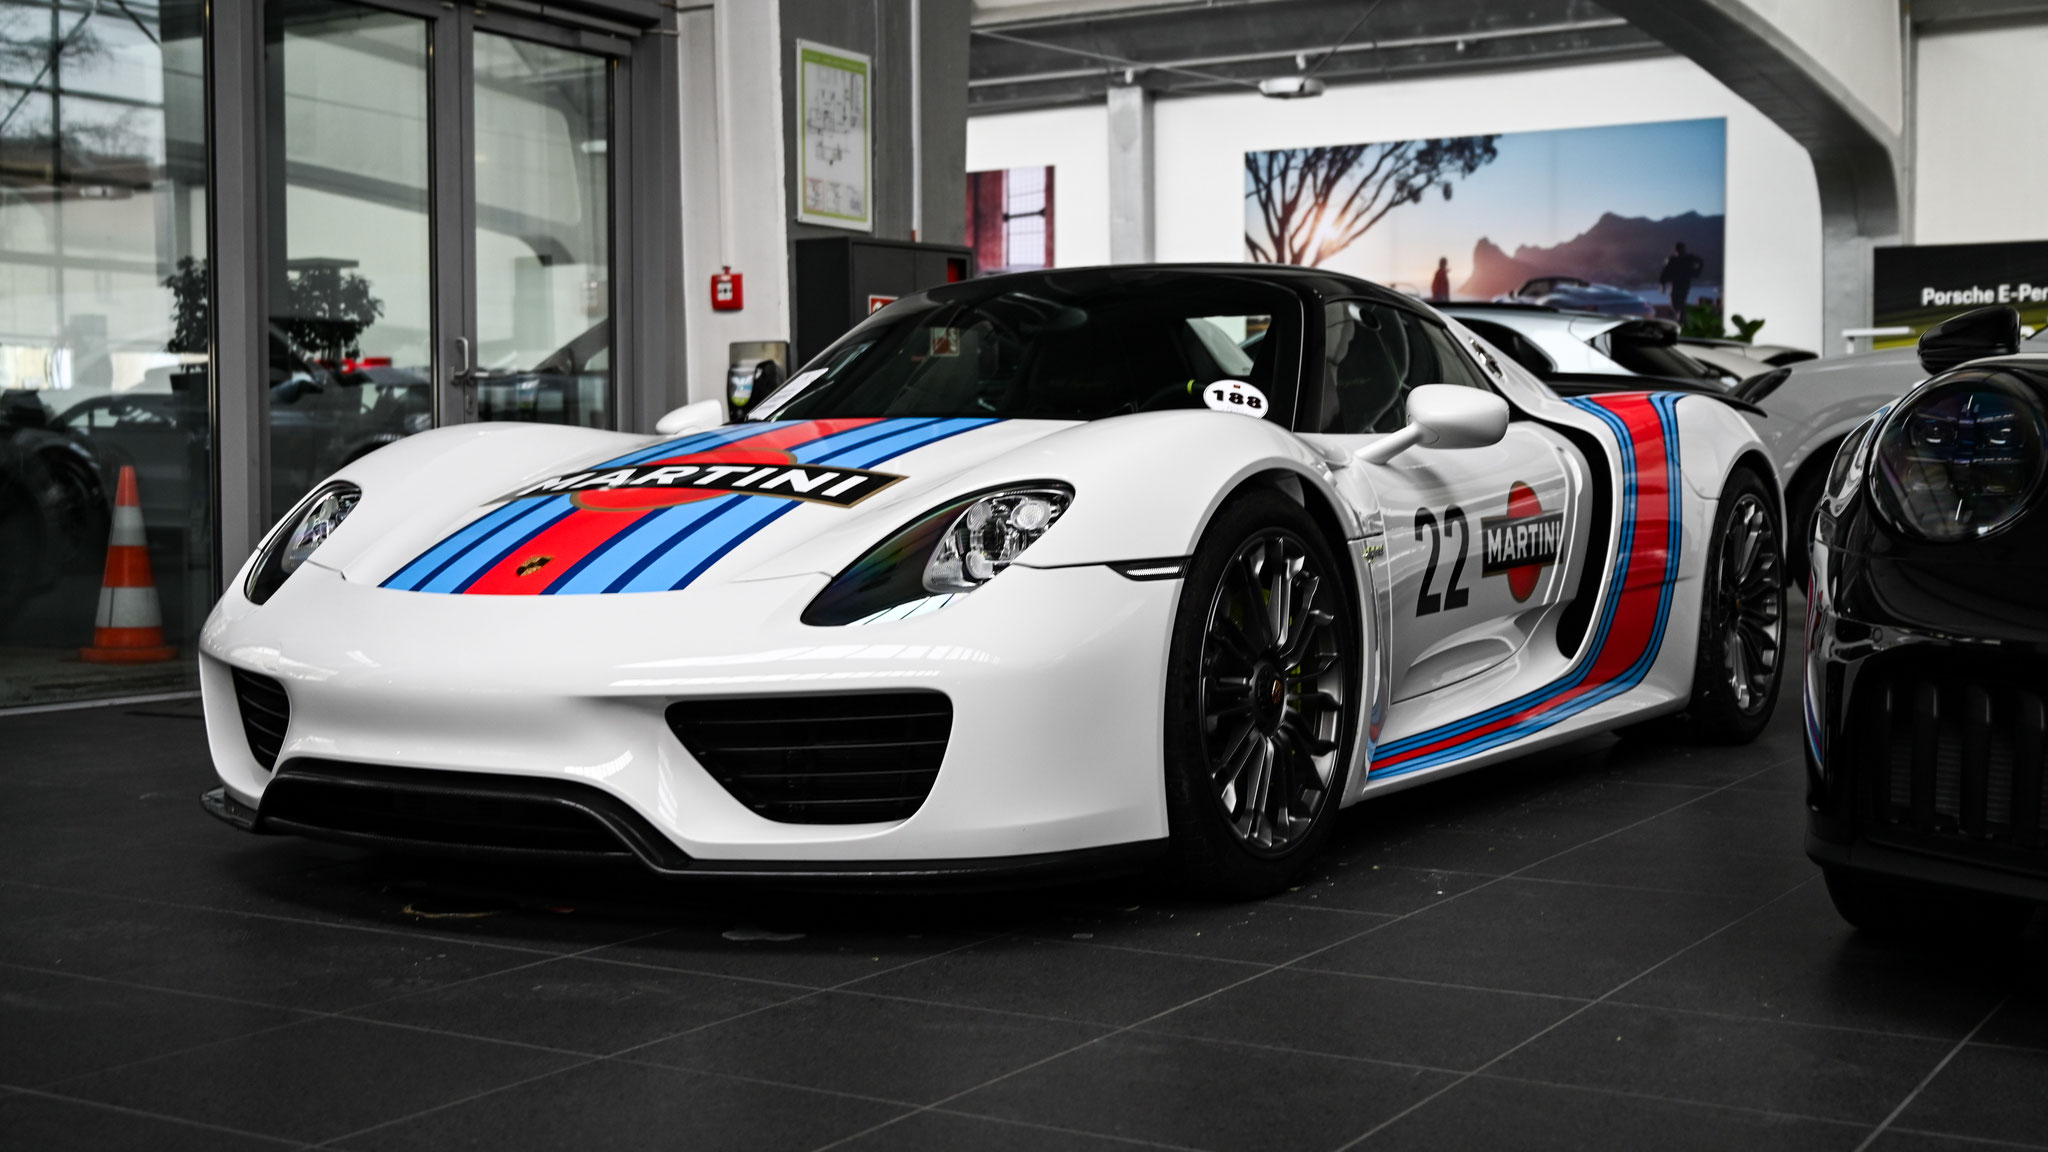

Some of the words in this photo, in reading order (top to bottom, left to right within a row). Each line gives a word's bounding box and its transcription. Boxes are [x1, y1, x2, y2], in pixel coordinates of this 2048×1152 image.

[1922, 285, 1995, 306] Porsche
[1212, 389, 1262, 409] 188
[515, 465, 868, 498] MARTINI
[1487, 520, 1560, 564] MARTINI
[1414, 504, 1470, 617] 22
